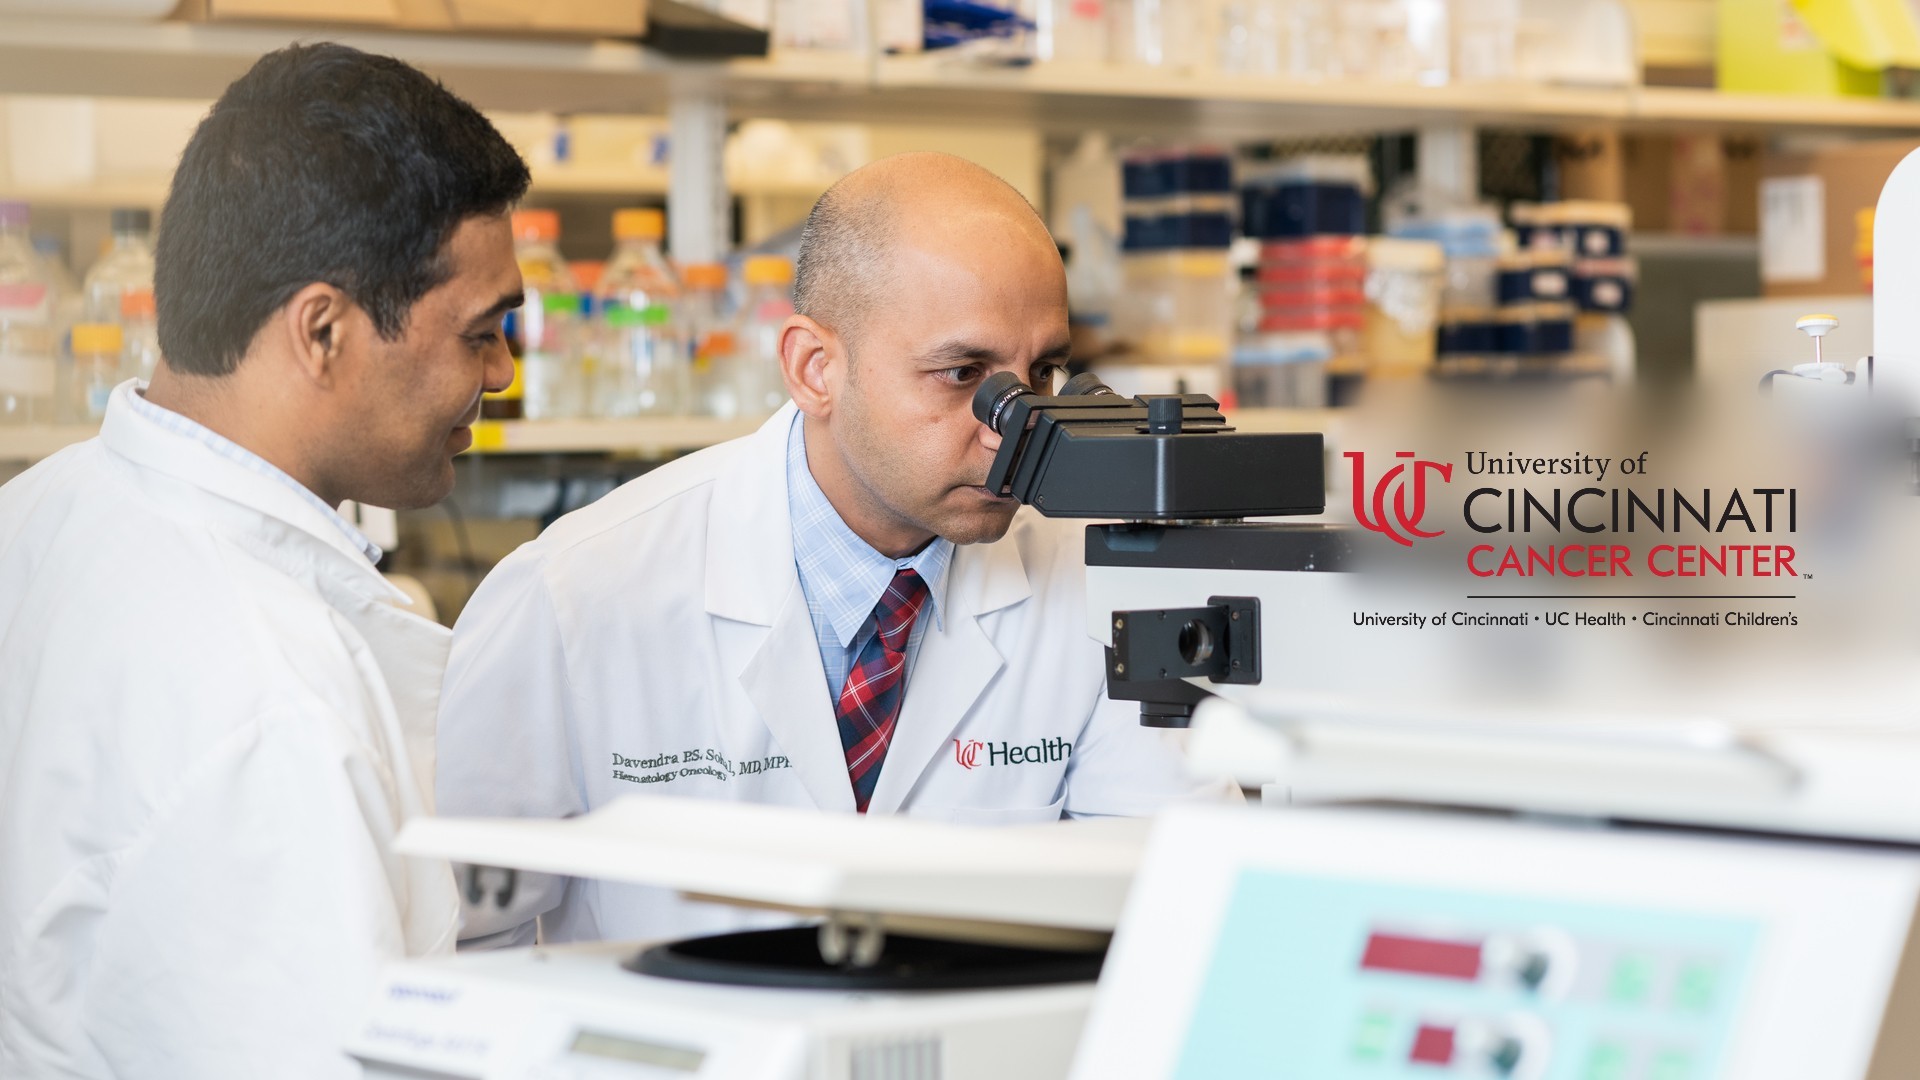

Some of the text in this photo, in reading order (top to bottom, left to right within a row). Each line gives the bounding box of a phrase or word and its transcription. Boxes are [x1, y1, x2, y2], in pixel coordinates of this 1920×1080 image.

[988, 737, 1072, 766] Health
[612, 753, 679, 769] Davendra
[612, 766, 726, 783] Hematology Oncology
